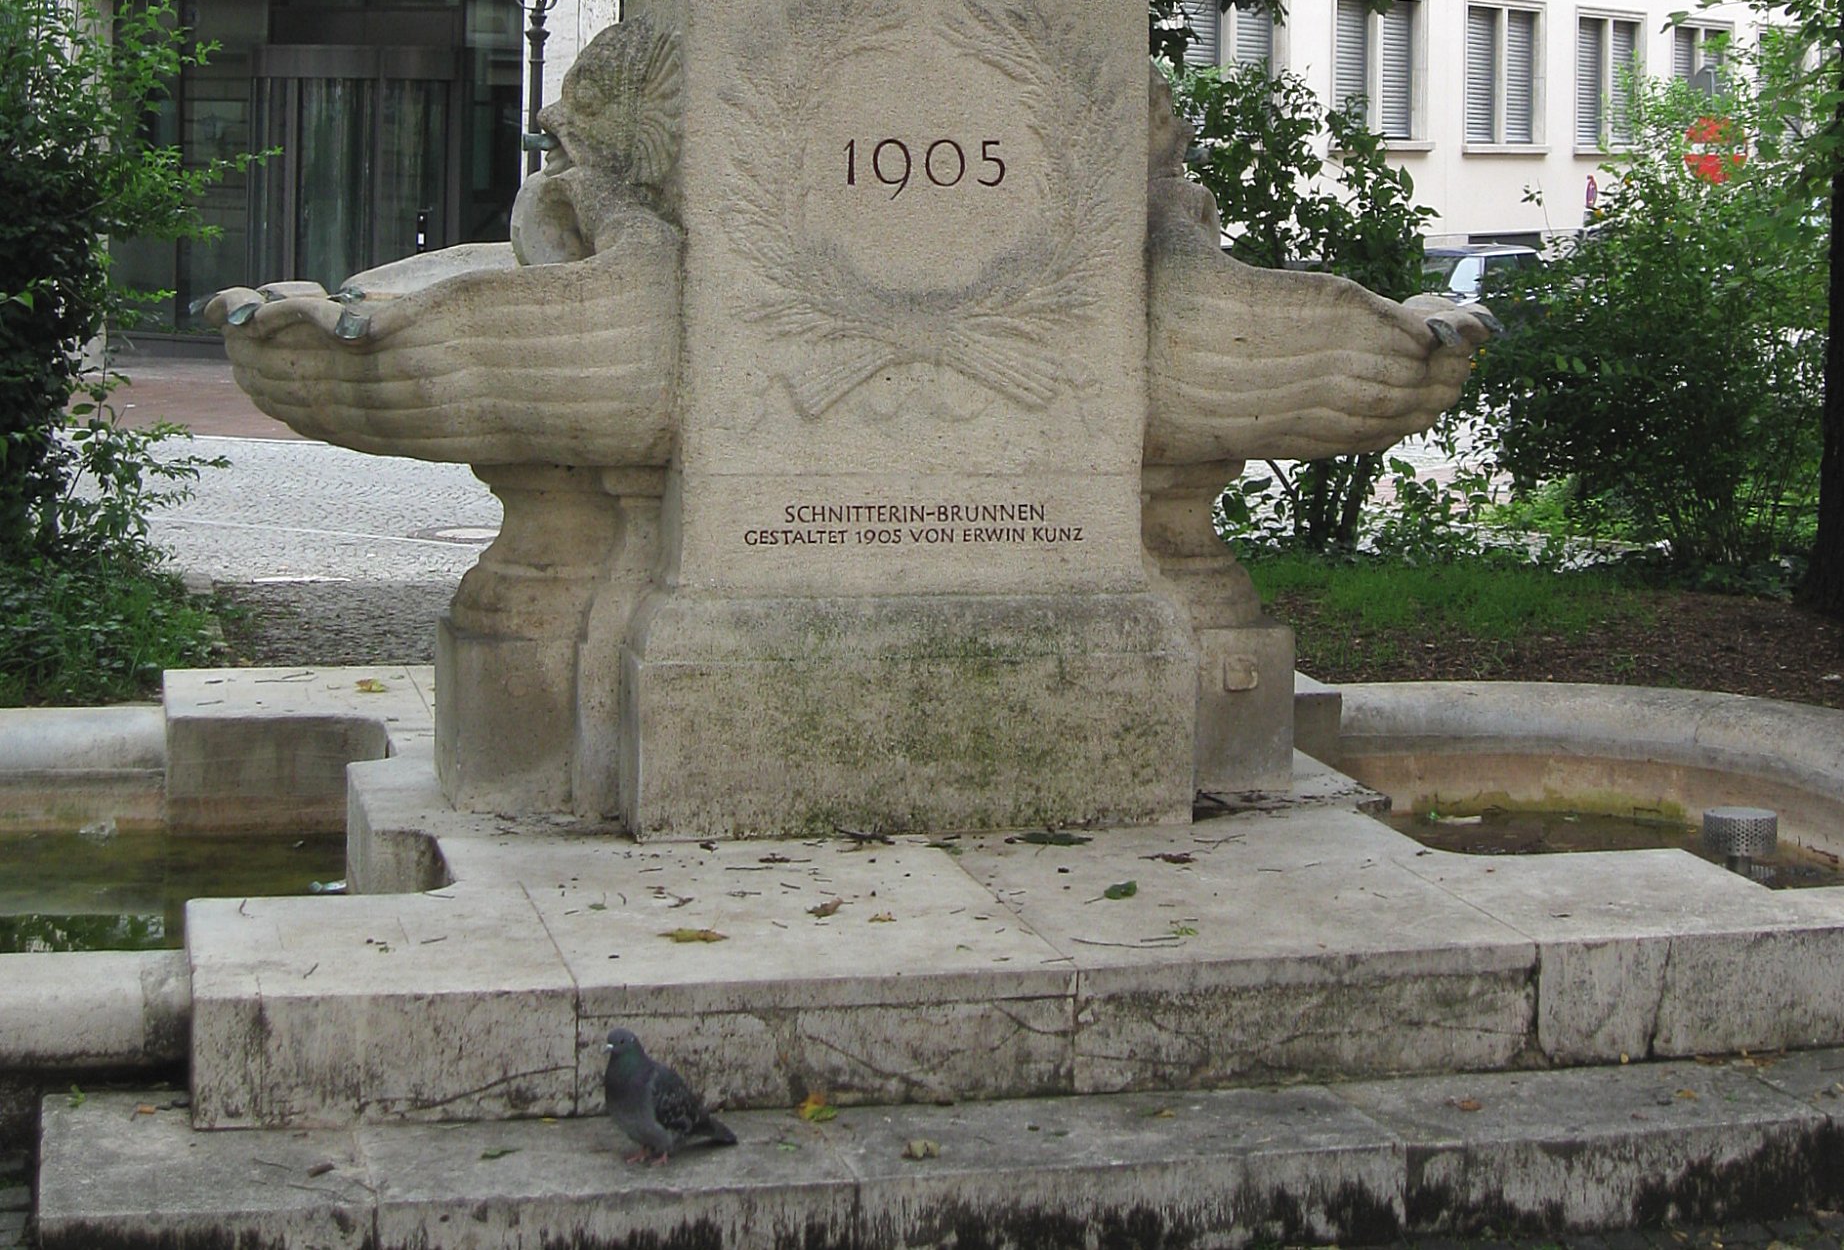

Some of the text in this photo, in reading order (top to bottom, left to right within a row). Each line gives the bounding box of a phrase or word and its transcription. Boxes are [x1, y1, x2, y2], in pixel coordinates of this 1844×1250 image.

[844, 138, 1006, 200] 1905
[784, 504, 1045, 524] SCHNITTERIN-BRUNNEN
[744, 526, 1084, 545] GESTALTET 1905 VON ERWIN KUNZ
